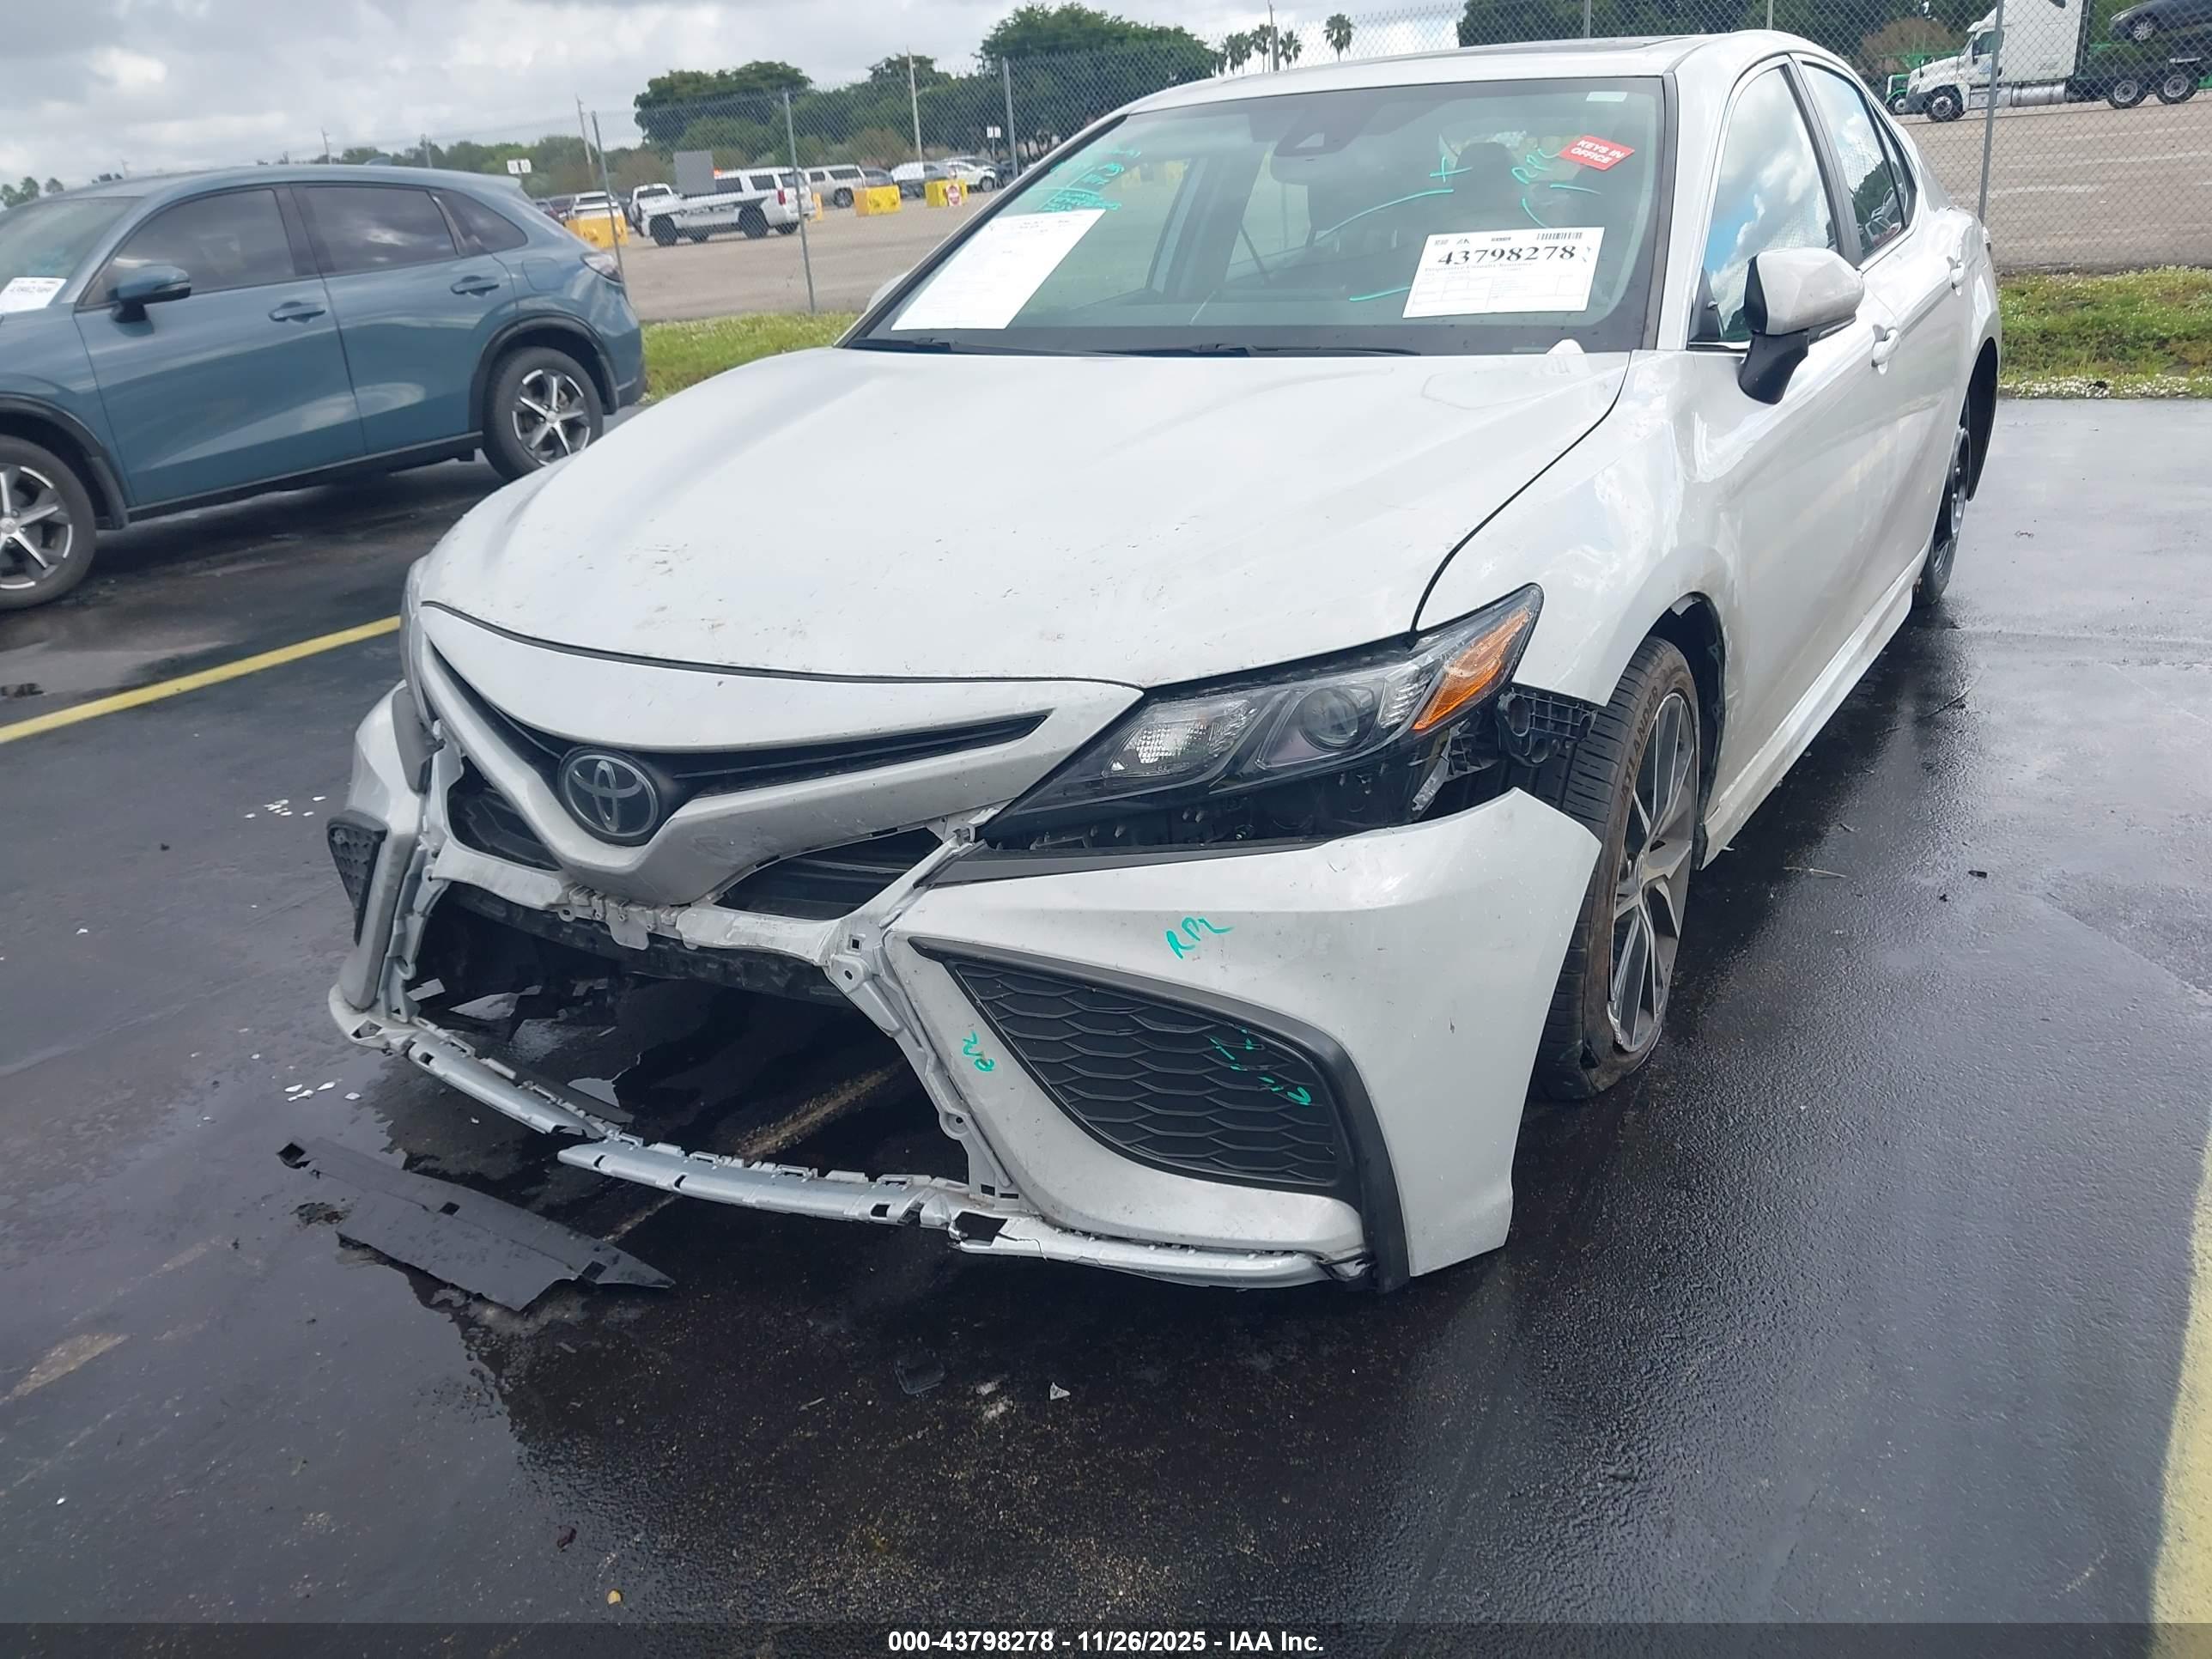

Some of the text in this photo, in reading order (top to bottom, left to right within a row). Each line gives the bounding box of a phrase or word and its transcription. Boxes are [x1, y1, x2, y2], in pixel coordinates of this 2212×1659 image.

[1571, 147, 1613, 163] OFFICE
[1577, 140, 1625, 159] KEYS IN
[1437, 245, 1577, 265] 43798278
